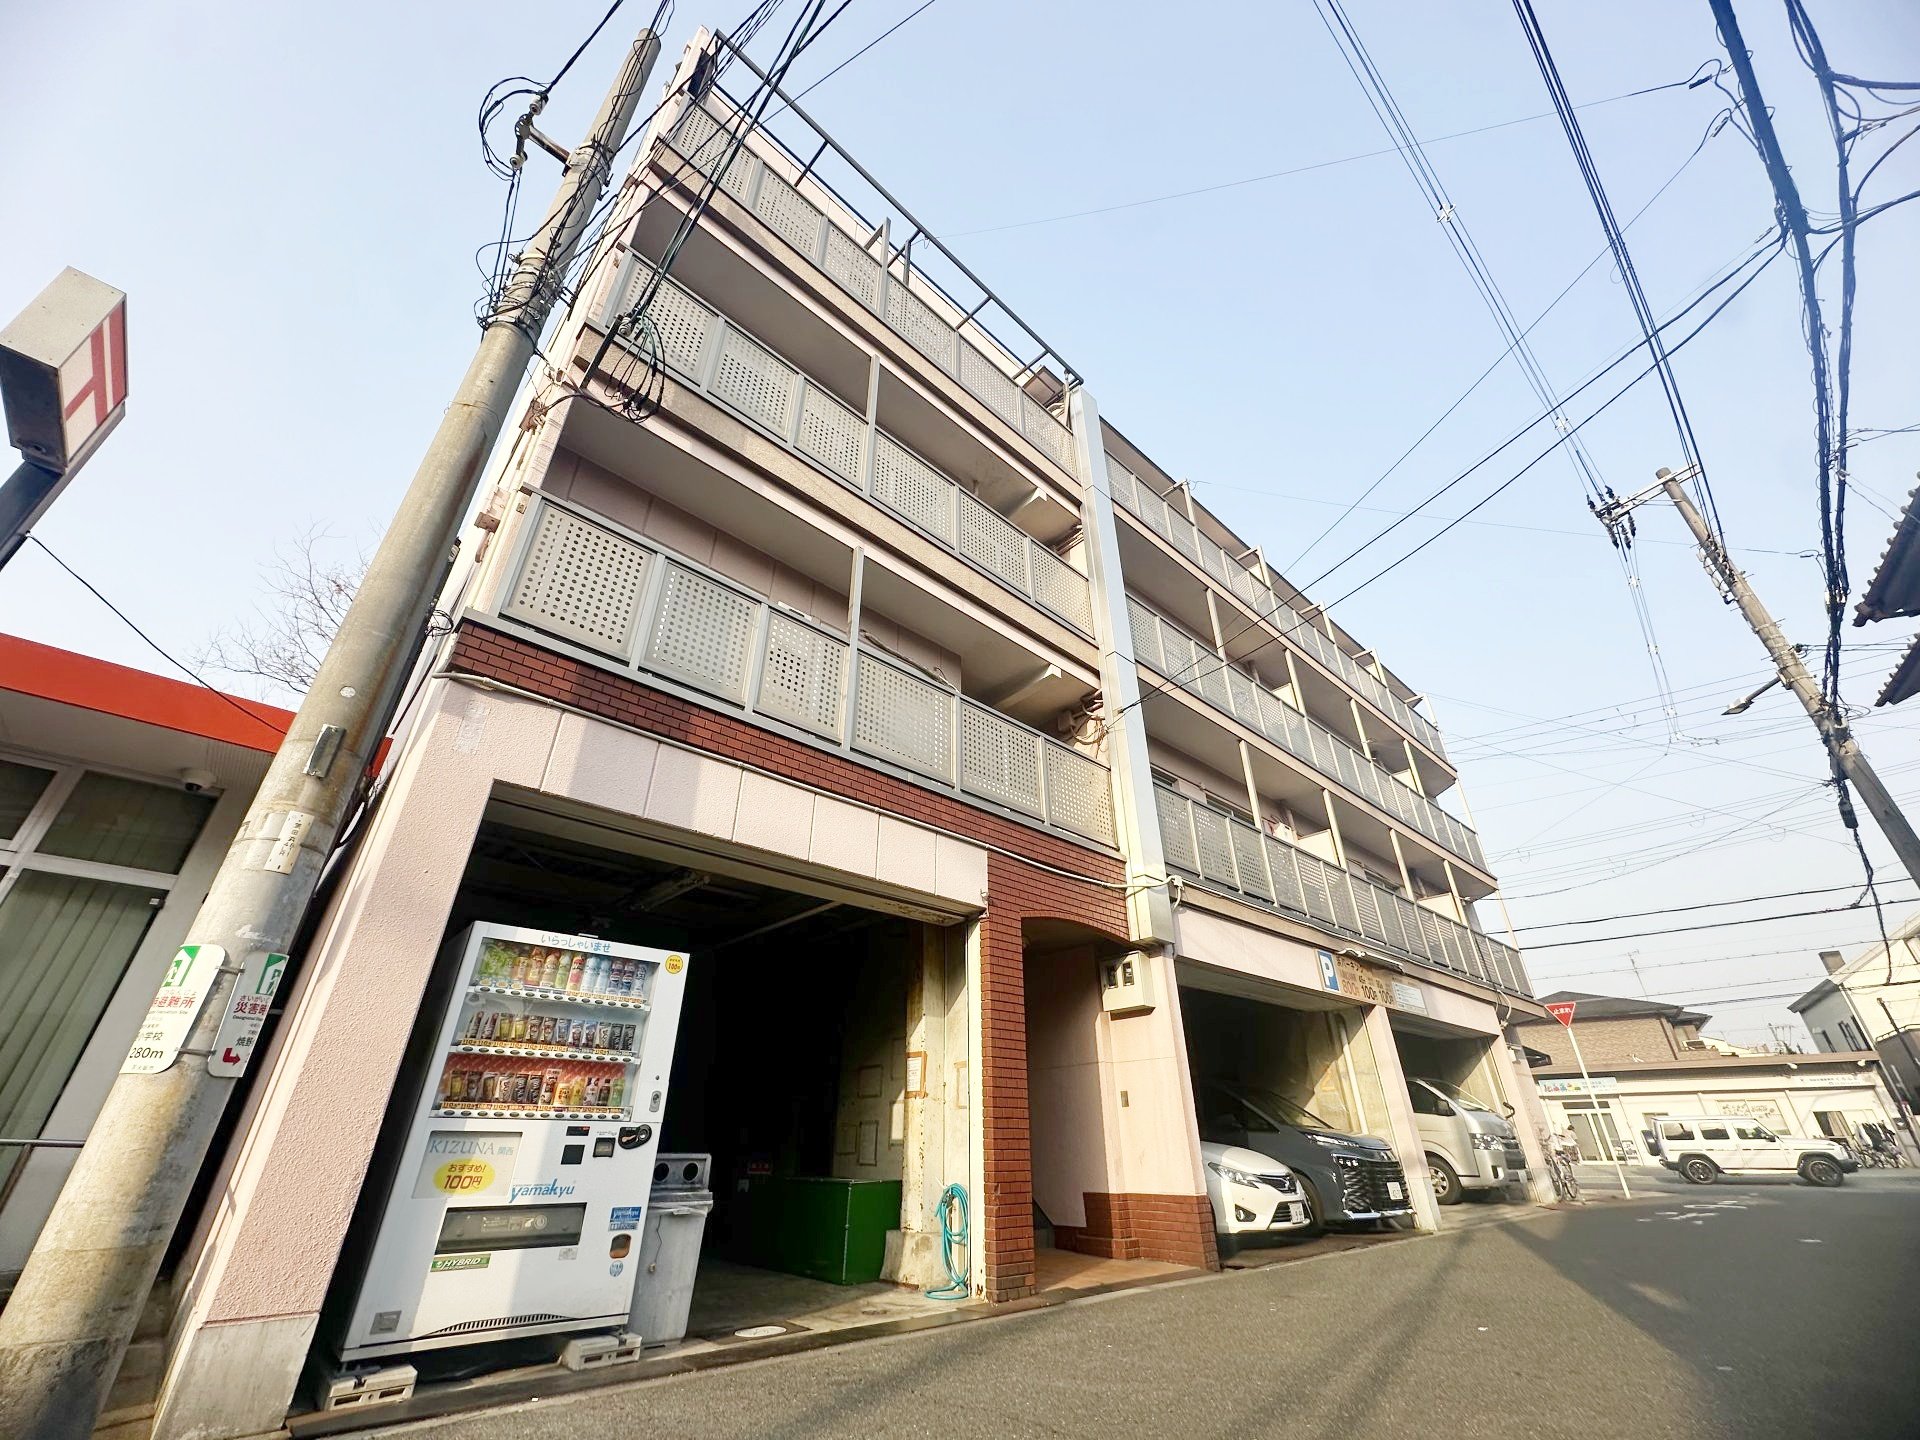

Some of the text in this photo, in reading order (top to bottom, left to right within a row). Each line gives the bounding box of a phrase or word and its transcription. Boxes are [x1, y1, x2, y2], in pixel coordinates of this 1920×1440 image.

[541, 934, 611, 953] いらっしゃいませ
[1320, 955, 1334, 986] P
[129, 1047, 164, 1059] 280m
[429, 1140, 495, 1156] KIZUNA
[448, 1163, 487, 1173] おすすめ!
[444, 1175, 483, 1189] 100円
[509, 1178, 576, 1203] yamakyu
[441, 1258, 481, 1270] HYBRID
